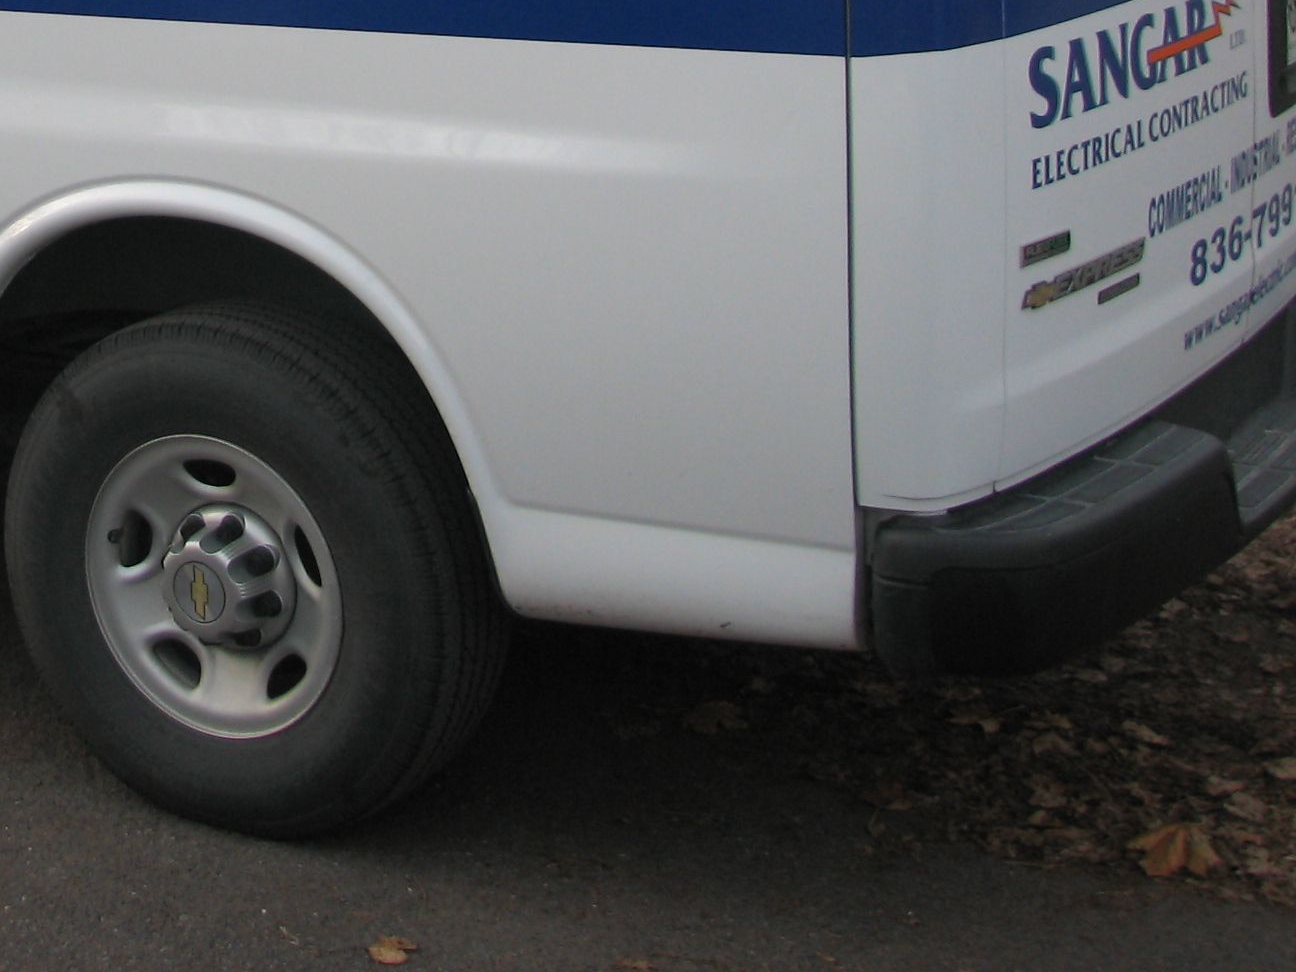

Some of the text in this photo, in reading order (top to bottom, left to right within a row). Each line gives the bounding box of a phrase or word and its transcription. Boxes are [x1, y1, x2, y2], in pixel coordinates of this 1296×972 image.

[1031, 70, 1248, 190] ELECTRICAL CONTRACTING
[1148, 164, 1223, 238] COMMERCIAL
[1230, 128, 1281, 195] INDUSTRIAL
[1189, 182, 1296, 287] 836-799
